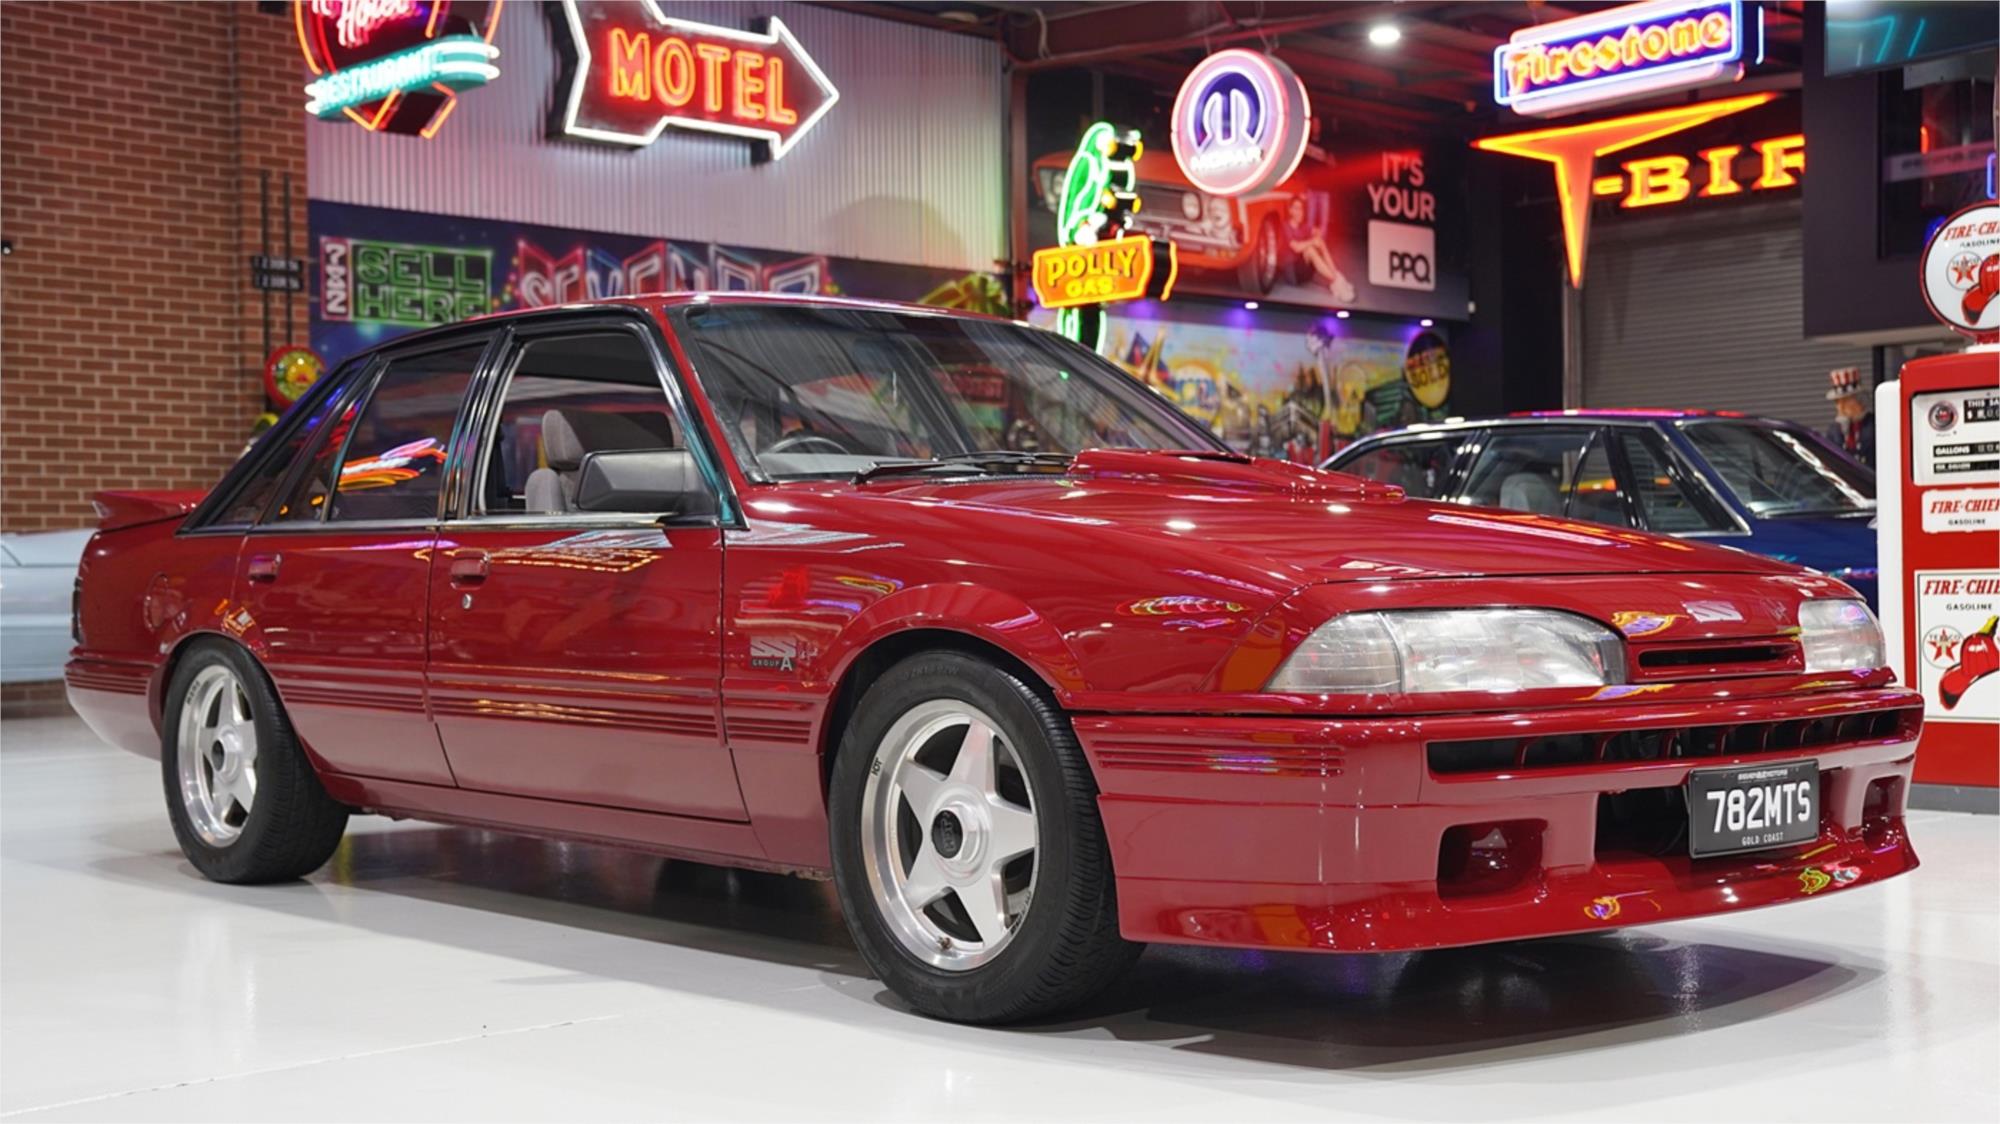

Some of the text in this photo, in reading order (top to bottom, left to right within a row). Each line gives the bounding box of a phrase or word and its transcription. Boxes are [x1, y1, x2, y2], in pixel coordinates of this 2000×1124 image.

[1503, 11, 1732, 96] Firestone
[608, 27, 798, 125] MOTEL
[1382, 152, 1425, 186] IT'S
[1368, 184, 1436, 221] YOUR
[1944, 220, 1999, 240] FIRE-CH
[357, 248, 487, 291] SELL
[1045, 247, 1137, 288] POLLY
[1389, 251, 1431, 284] PPQ
[357, 283, 487, 323] HERE
[1065, 275, 1114, 298] GAS
[1935, 446, 1970, 455] GALLONS
[1948, 518, 1986, 526] GASOLINE
[1946, 603, 1992, 611] GASOLINE
[780, 655, 793, 671] A
[1706, 781, 1811, 833] 782MTS
[1742, 832, 1784, 846] GOLD COAST
